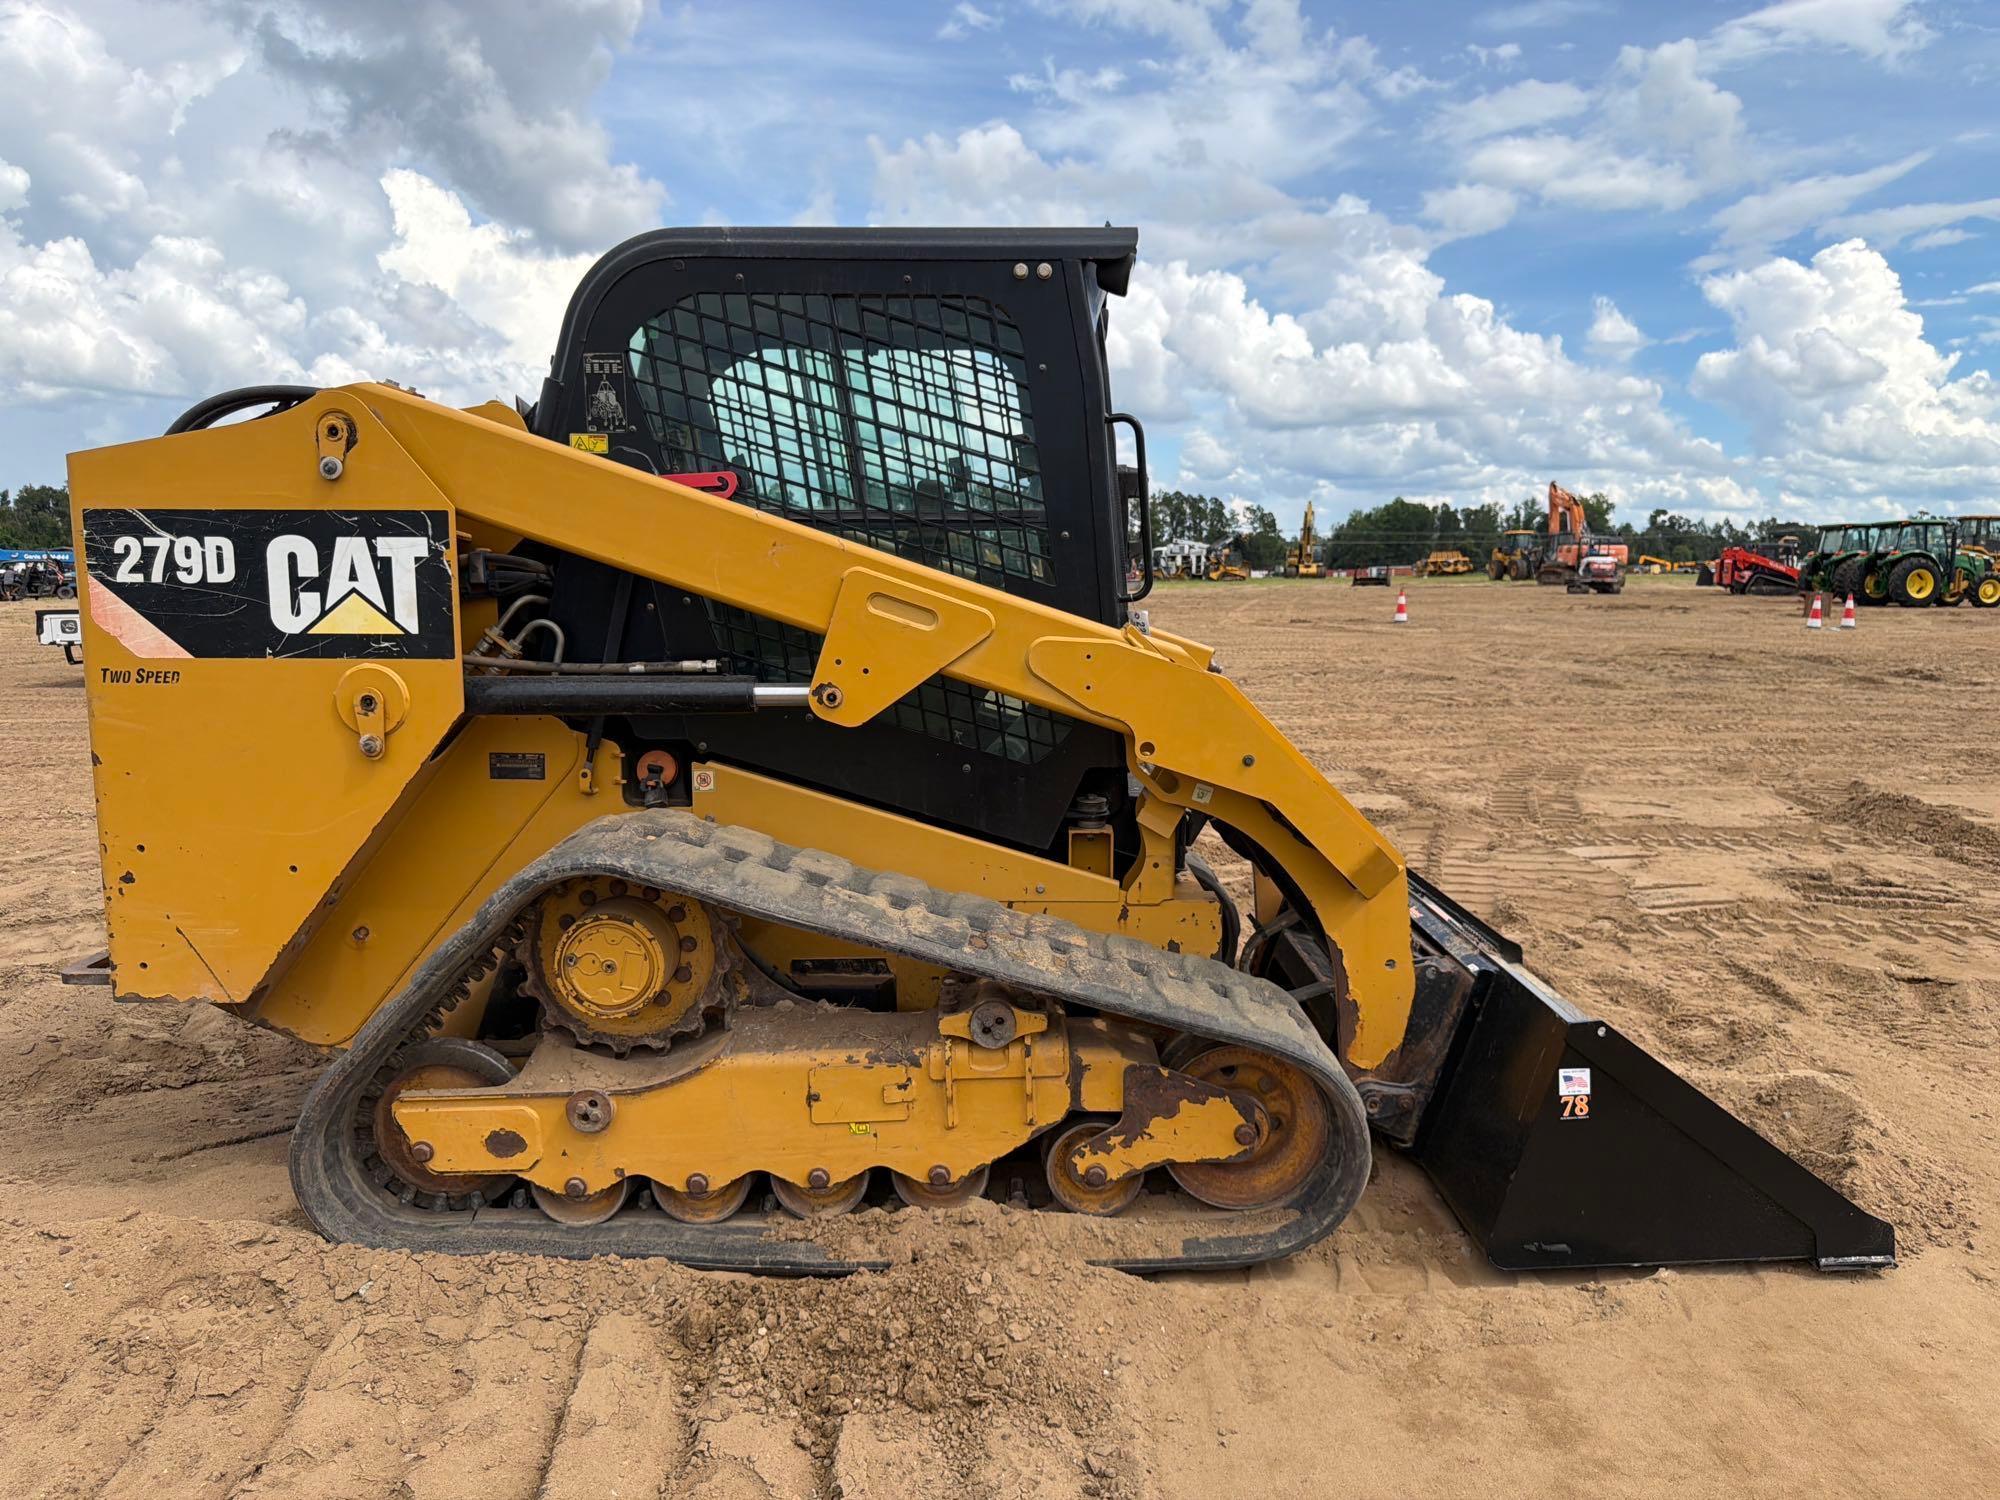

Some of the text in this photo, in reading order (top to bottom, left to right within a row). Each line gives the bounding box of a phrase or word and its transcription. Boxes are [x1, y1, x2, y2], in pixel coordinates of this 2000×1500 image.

[114, 534, 429, 634] 279D CAT
[1560, 1095, 1589, 1117] 78
